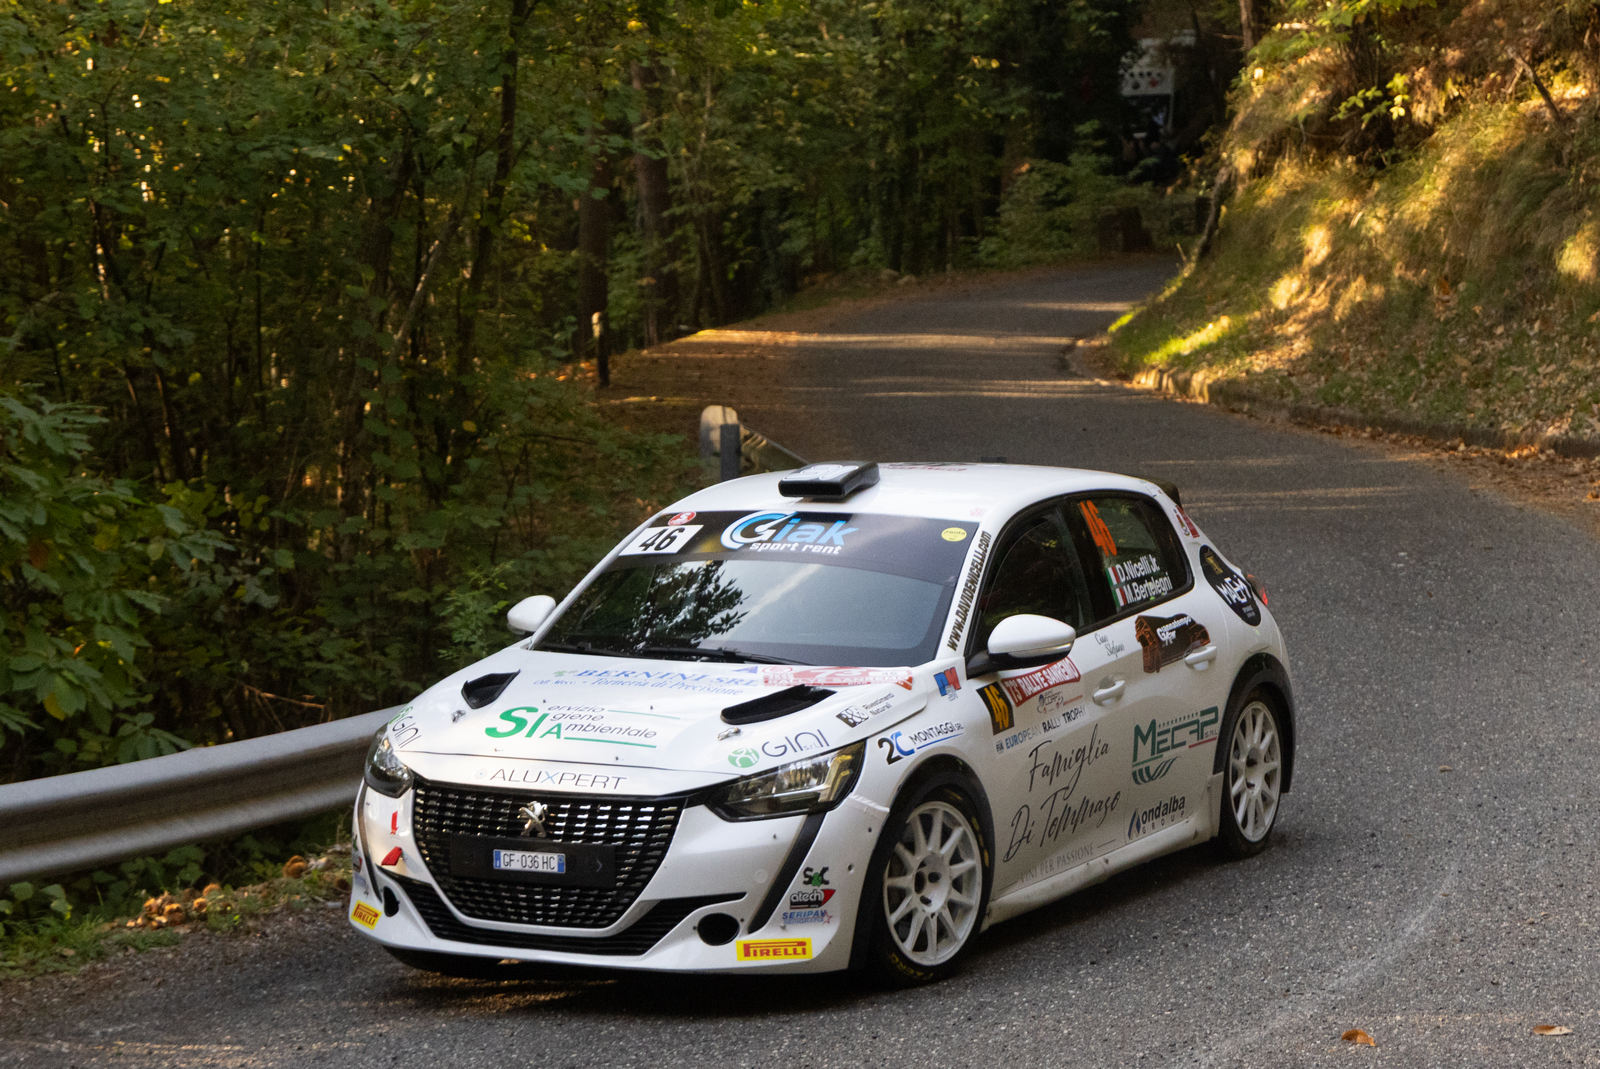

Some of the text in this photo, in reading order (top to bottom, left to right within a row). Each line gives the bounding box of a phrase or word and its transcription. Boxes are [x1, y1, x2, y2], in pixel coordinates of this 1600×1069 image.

[639, 527, 685, 552] 46
[1080, 500, 1117, 556] 46
[749, 541, 843, 554] sport rent
[577, 670, 709, 682] BERNINI
[1016, 670, 1049, 697] RALLYE
[1042, 657, 1080, 686] SANREMO
[984, 685, 1010, 730] 46
[1042, 716, 1062, 733] RALLY
[1062, 705, 1088, 724] TROPHY
[909, 721, 956, 745] MONTAGGI
[490, 769, 628, 790] ALUXPERT
[353, 903, 379, 926] PIRELLI
[743, 941, 807, 957] PIRELLI
